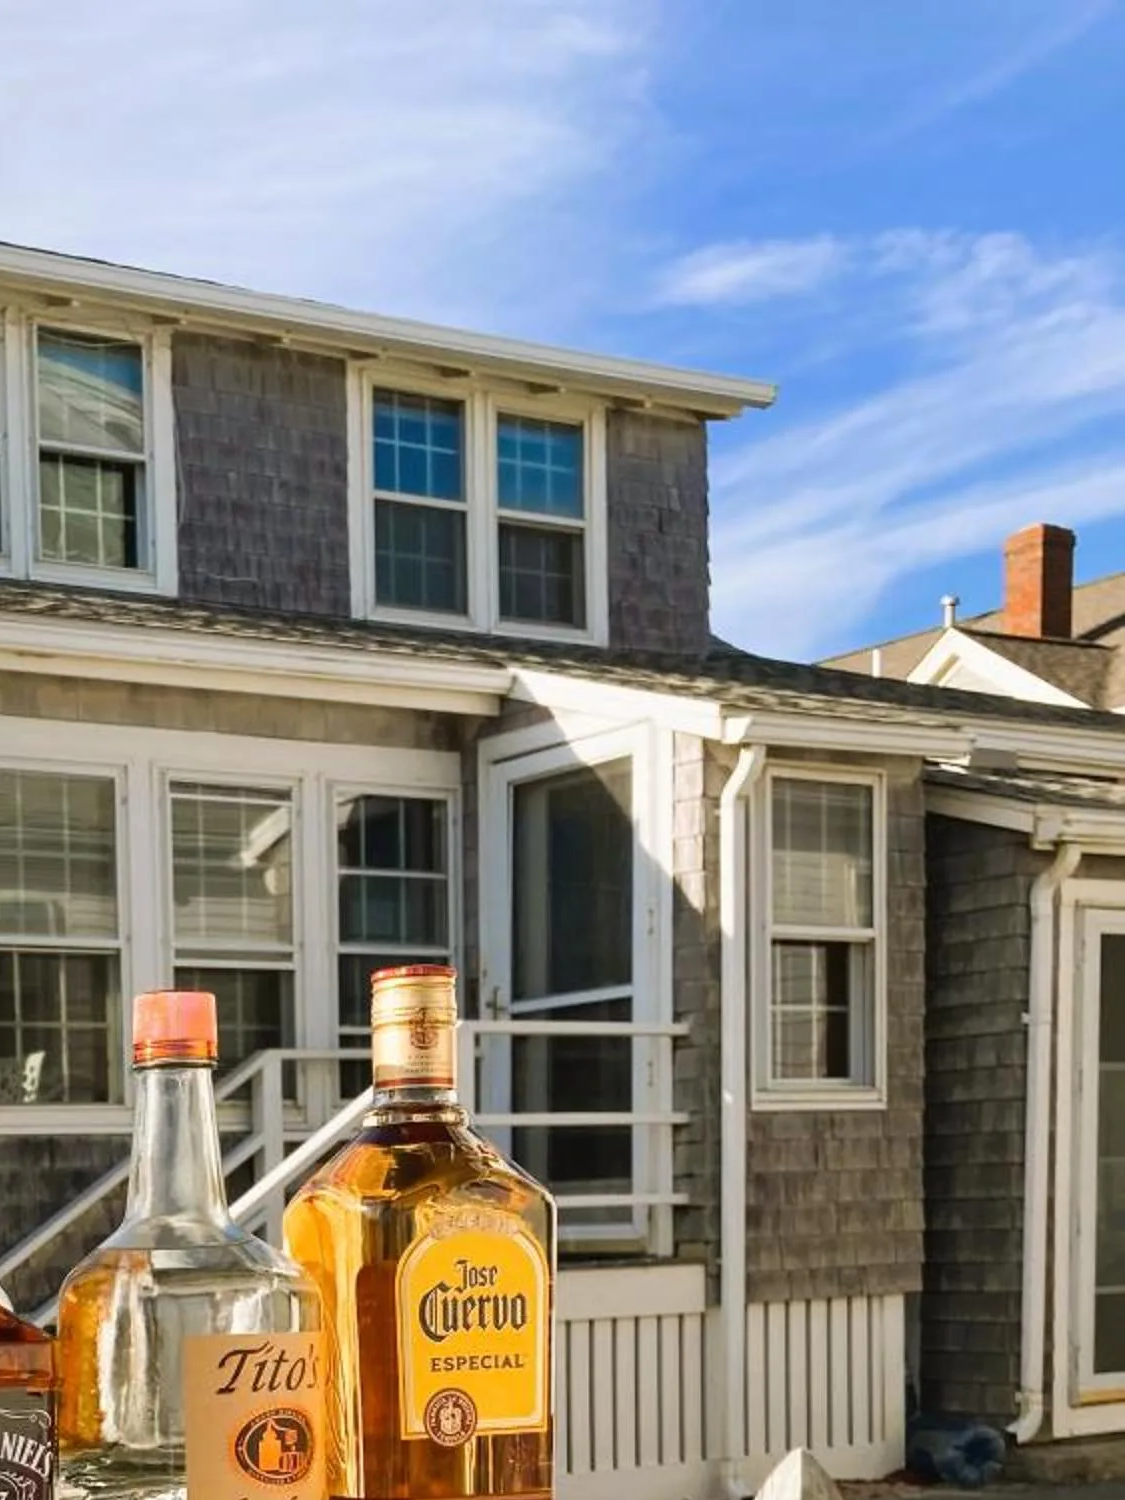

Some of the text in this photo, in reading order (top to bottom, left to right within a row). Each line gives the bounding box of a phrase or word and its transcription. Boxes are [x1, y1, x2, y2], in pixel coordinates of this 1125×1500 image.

[454, 1259, 499, 1294] Jose
[419, 1280, 528, 1343] Cuervo
[430, 1353, 524, 1373] ESPECIAL
